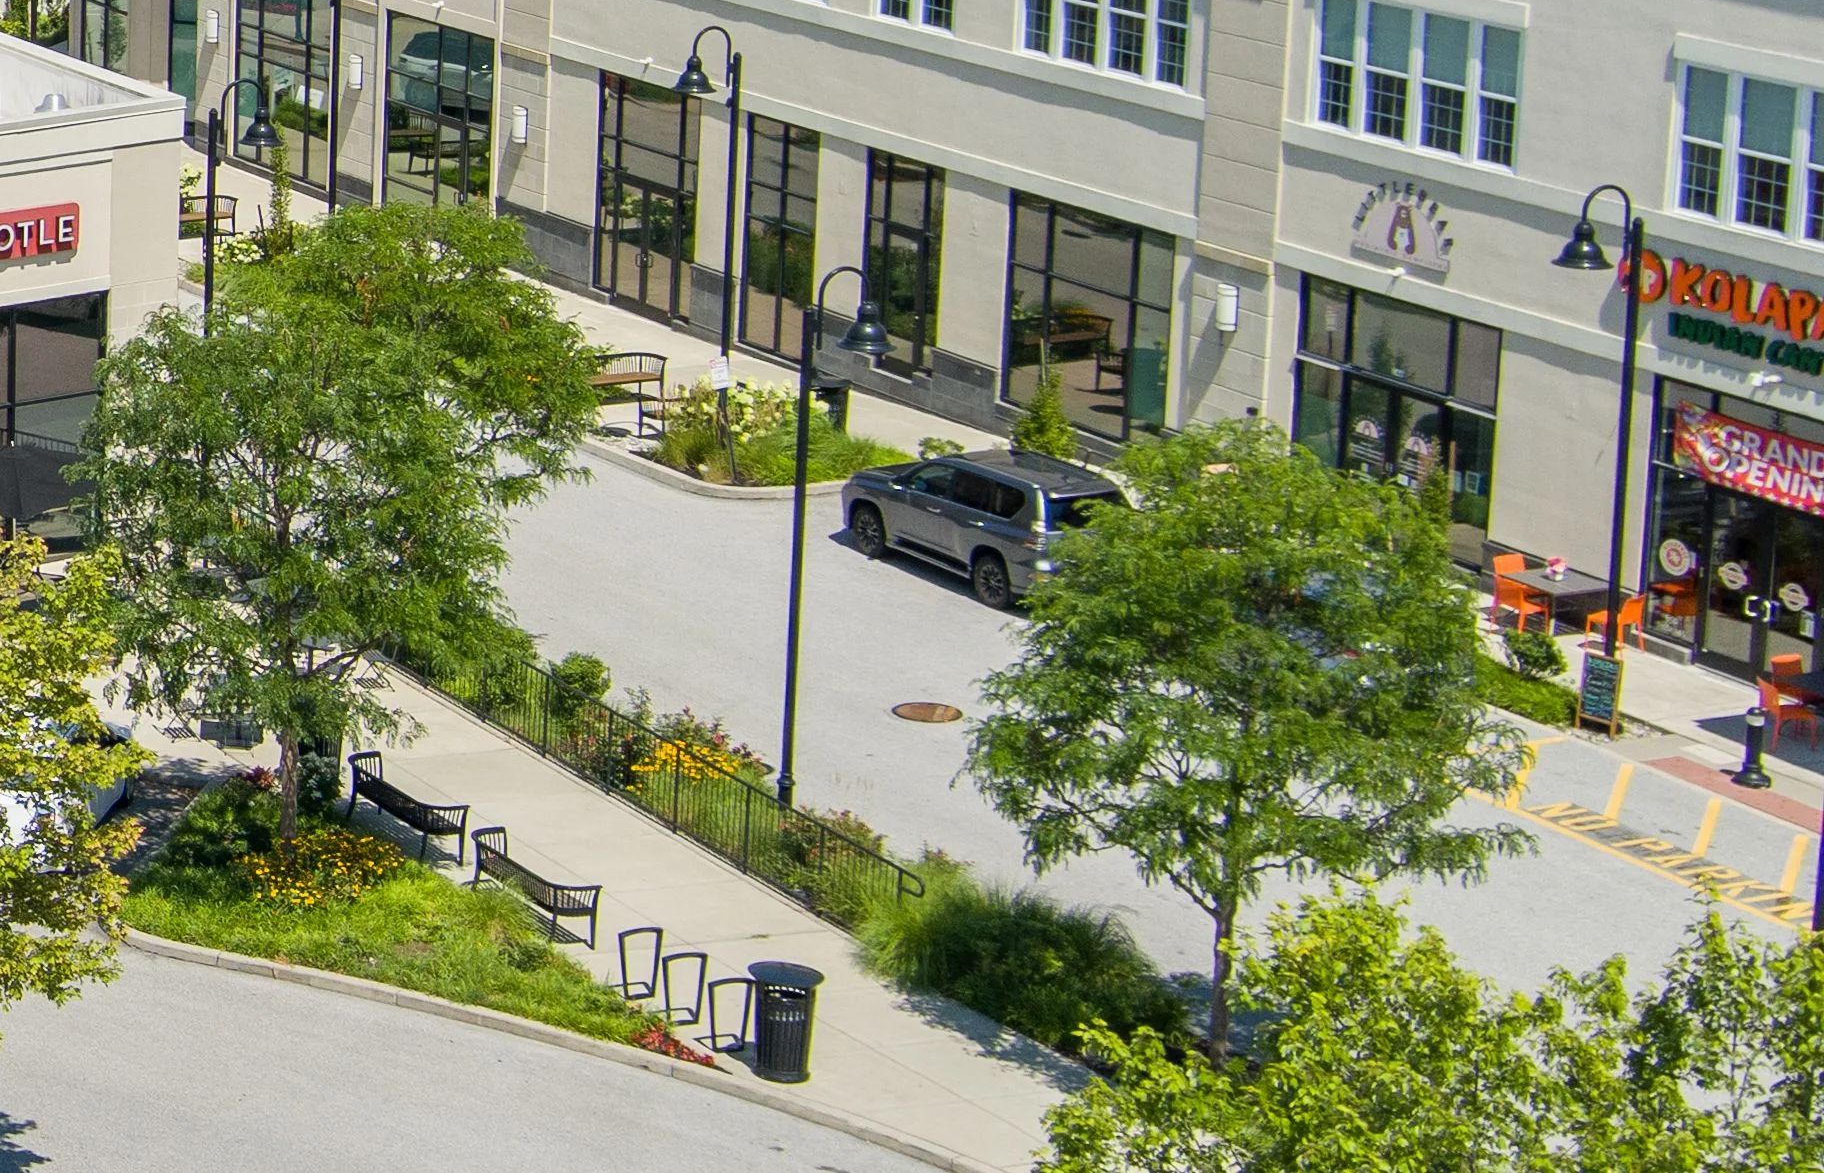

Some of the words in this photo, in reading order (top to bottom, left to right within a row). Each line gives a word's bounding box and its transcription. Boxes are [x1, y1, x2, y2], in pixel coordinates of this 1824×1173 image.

[1668, 312, 1766, 360] INDIAN
[1720, 425, 1824, 479] GRAND
[1527, 801, 1619, 831] NO
